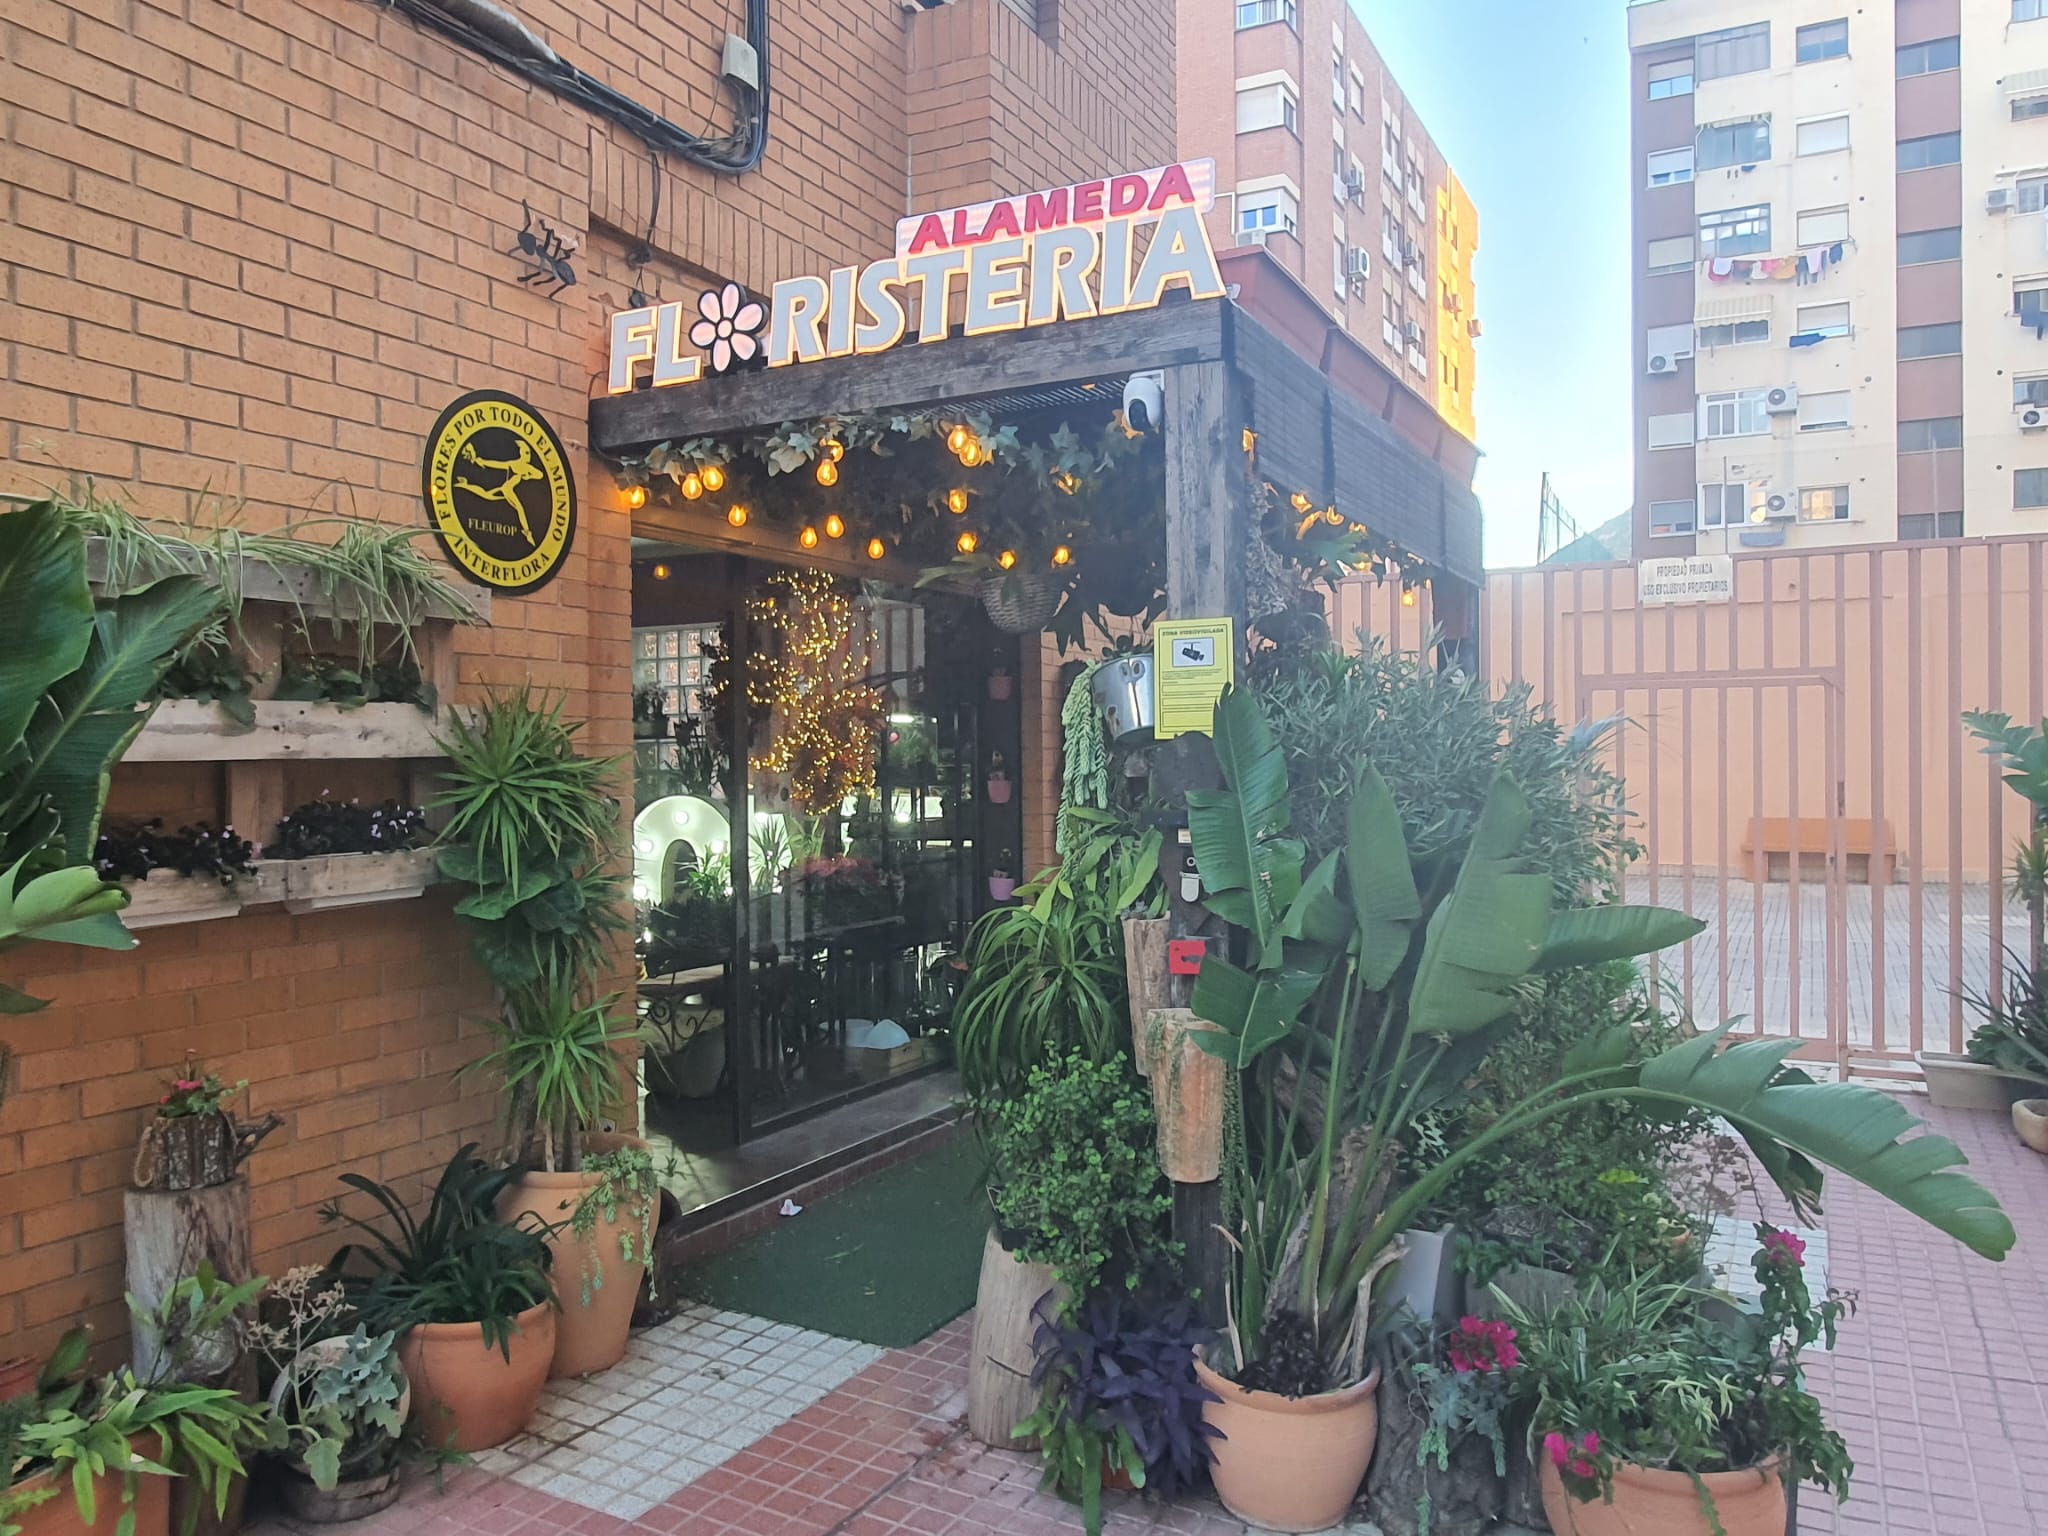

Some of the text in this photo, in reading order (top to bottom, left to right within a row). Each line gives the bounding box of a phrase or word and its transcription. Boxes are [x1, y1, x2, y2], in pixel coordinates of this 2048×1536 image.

[908, 163, 1196, 254] ALAMEDA
[435, 406, 567, 542] FLORES POR TODO EL MUNDO
[468, 517, 518, 537] FLEUROP
[453, 537, 550, 581] INTERFLORA
[1656, 564, 1688, 576] PROPIEDAD
